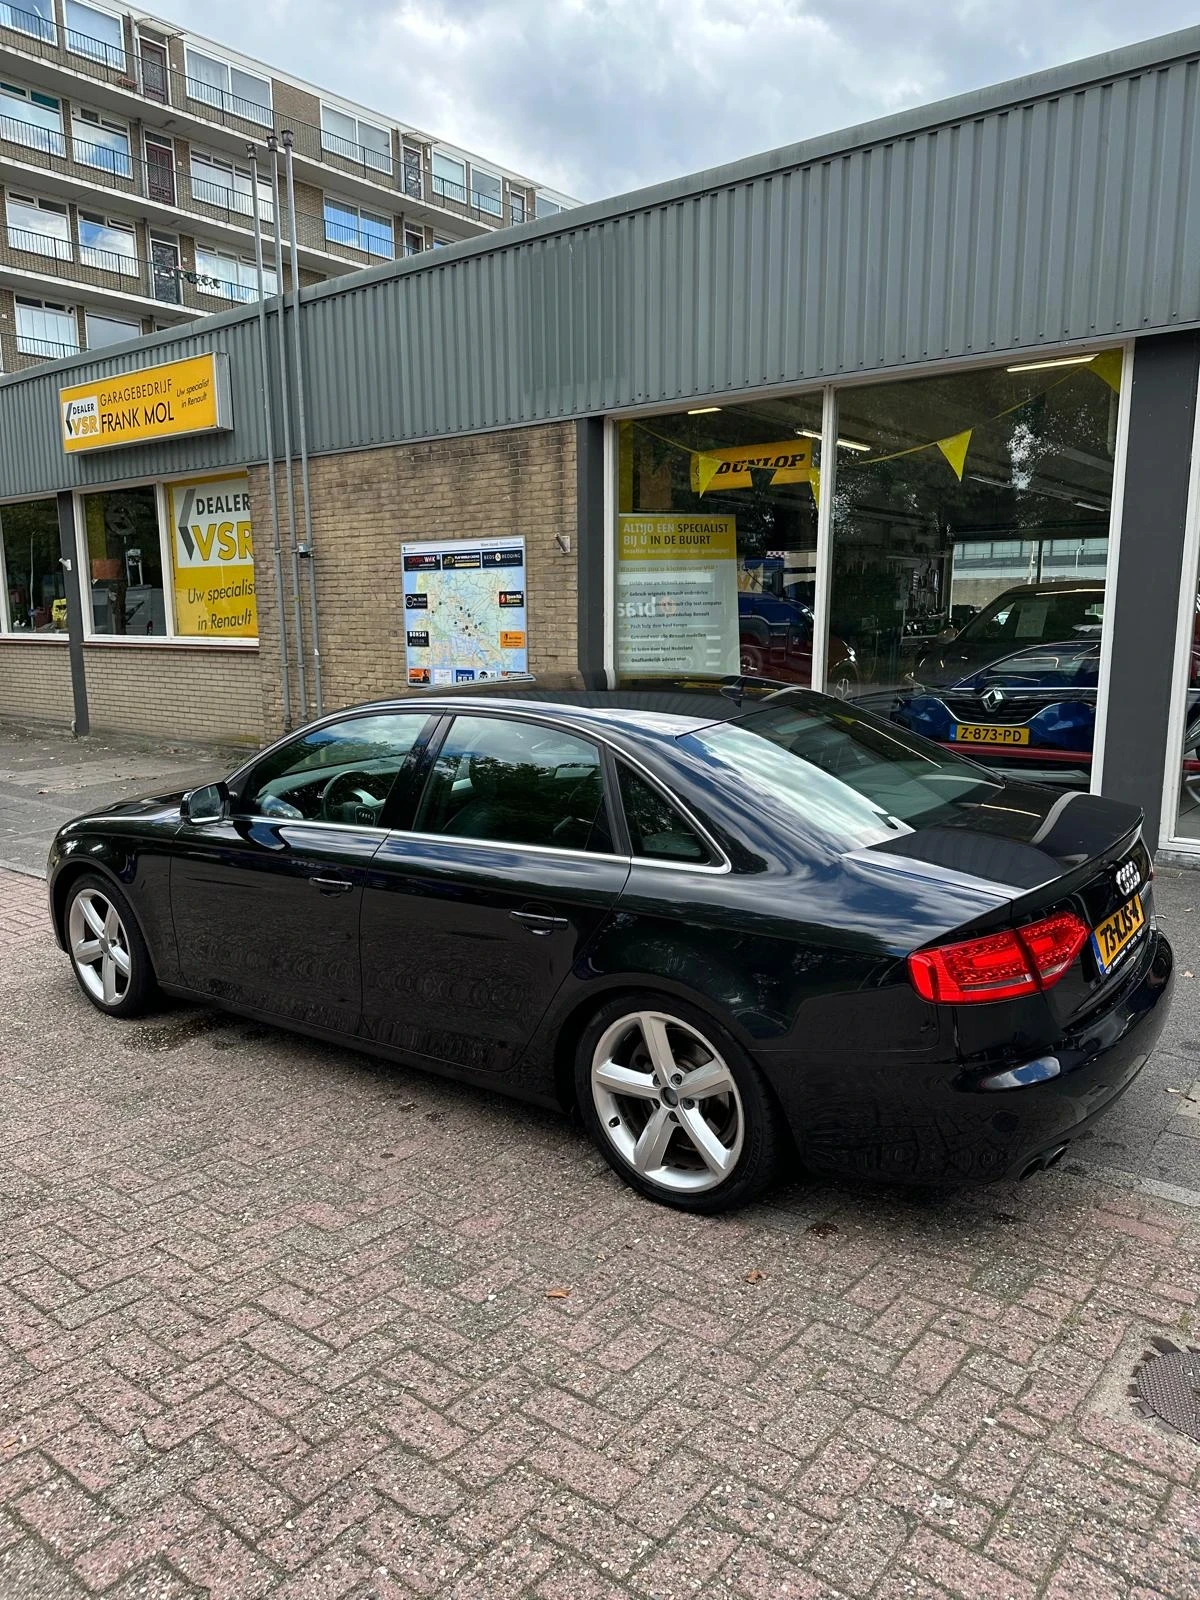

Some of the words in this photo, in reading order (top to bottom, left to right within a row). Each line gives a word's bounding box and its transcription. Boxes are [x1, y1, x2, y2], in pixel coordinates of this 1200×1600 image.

[100, 378, 173, 407] GARAGEBEDRIJF
[176, 387, 186, 397] Uw
[186, 377, 210, 395] specialist
[72, 402, 95, 415] DEALER
[181, 400, 187, 408] in
[187, 391, 207, 406] Renault
[71, 415, 99, 435] VSR
[101, 407, 140, 434] FRANK
[144, 401, 174, 426] MOL
[714, 453, 806, 475] DUNLOP
[196, 493, 250, 516] DEALER
[623, 523, 654, 535] ALTIJD
[657, 523, 675, 533] EEN
[678, 523, 729, 533] SPECIALIST
[191, 521, 254, 561] VSR
[623, 535, 637, 547] BIJ
[641, 535, 648, 545] U
[650, 535, 661, 545] IN
[664, 535, 677, 545] DE
[679, 535, 711, 545] BUURT
[188, 588, 205, 604] Uw
[198, 615, 207, 631] in
[210, 608, 253, 630] Renault
[961, 727, 1022, 742] Z-873-PD
[1100, 898, 1140, 959] 73-KJS-4
